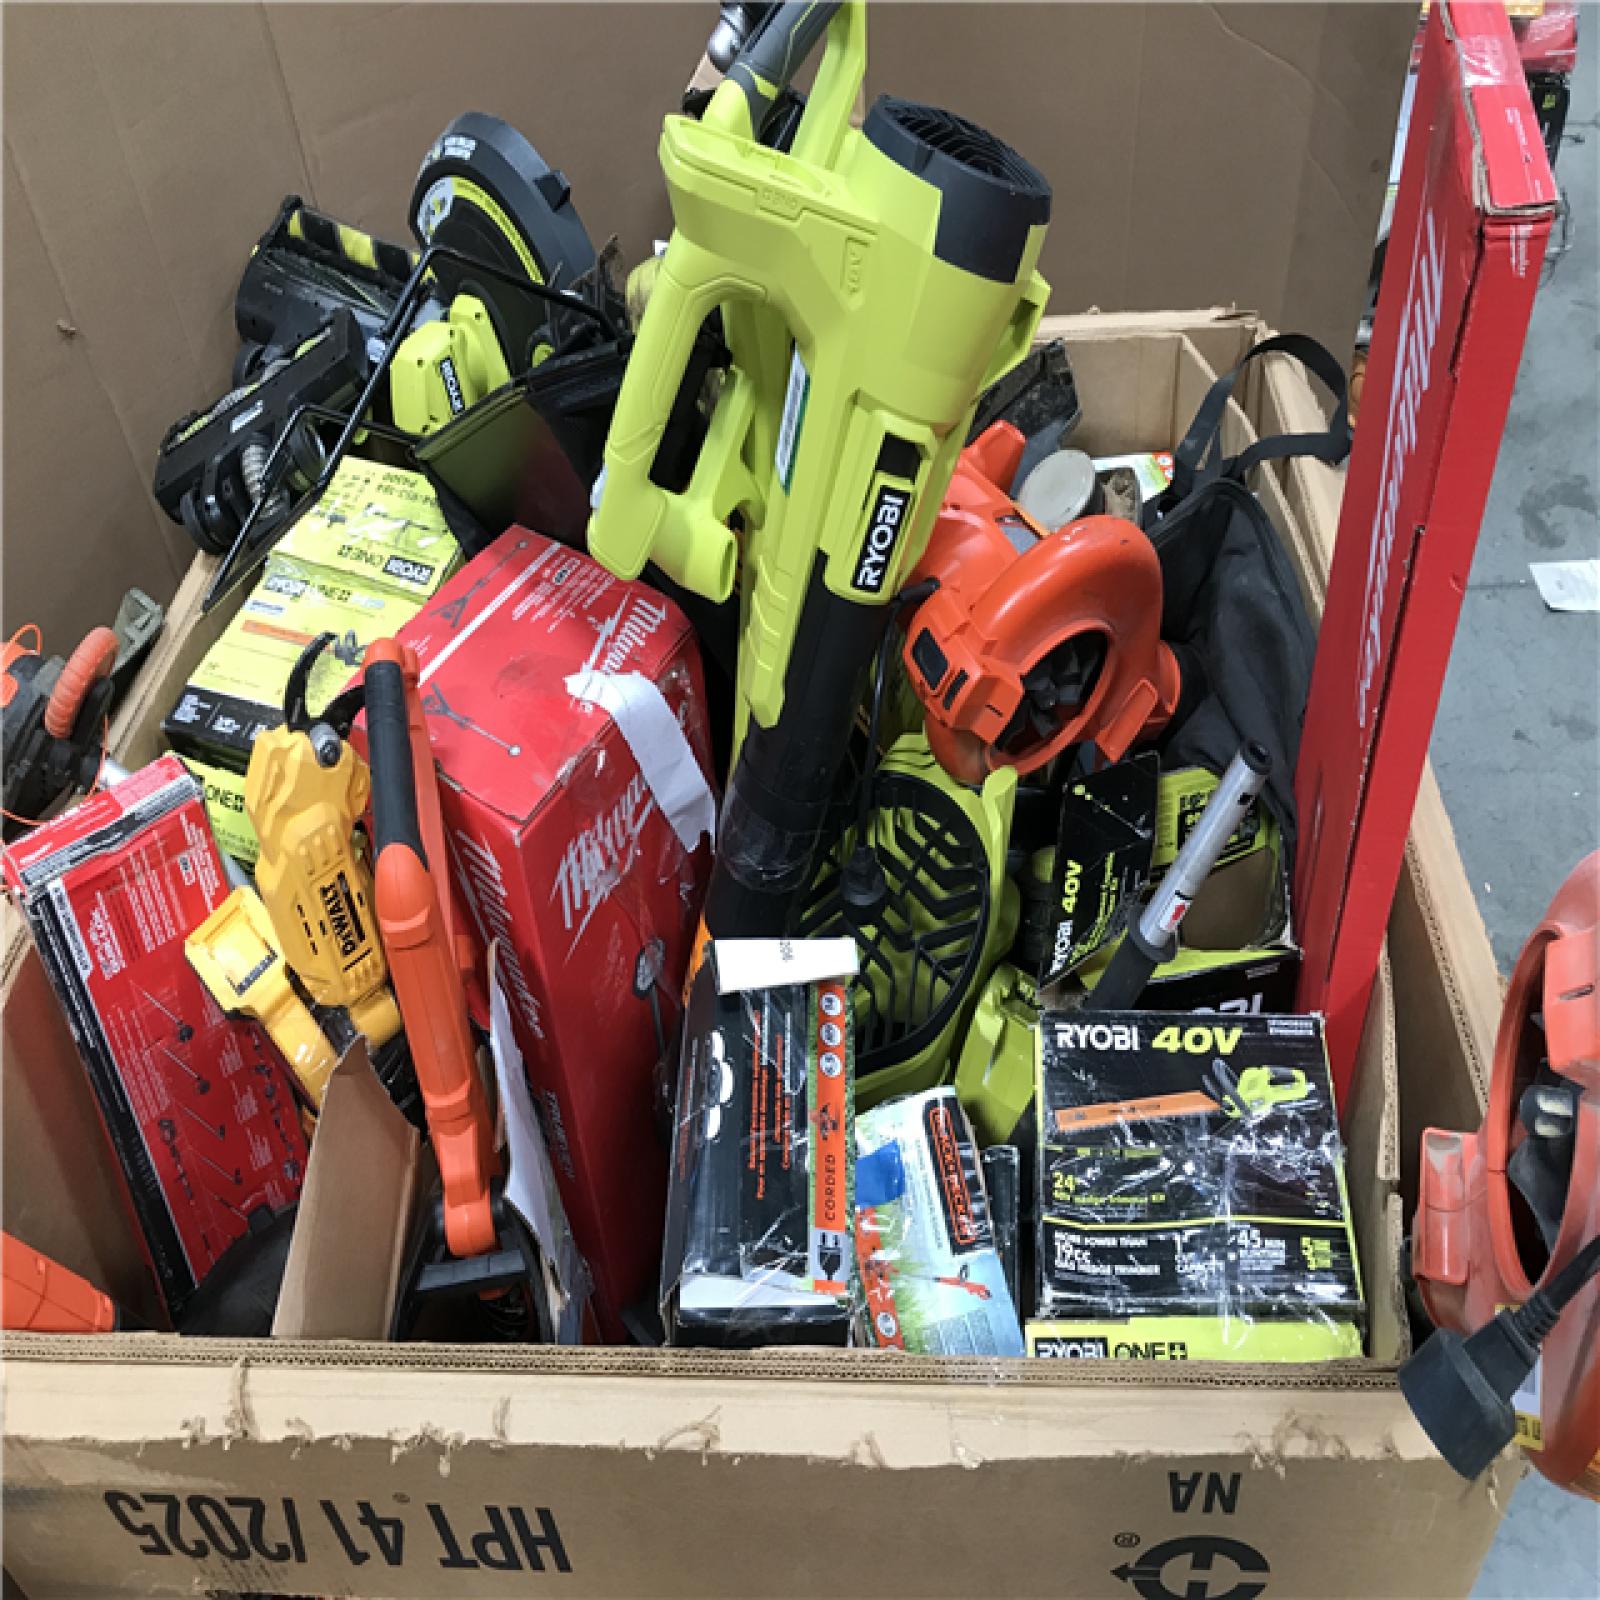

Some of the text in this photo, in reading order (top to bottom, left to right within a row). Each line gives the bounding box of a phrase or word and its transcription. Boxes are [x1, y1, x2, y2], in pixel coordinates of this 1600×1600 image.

[440, 358, 465, 416] RYOBI
[1356, 208, 1446, 728] Milwaukee
[855, 494, 907, 590] RYOBI
[1061, 859, 1083, 914] 40V
[319, 883, 357, 957] DEWALT
[455, 828, 546, 1040] Milwaukee
[1053, 1023, 1141, 1052] RYOBI
[1151, 1026, 1244, 1056] 40V
[824, 1154, 836, 1221] CORDED
[1114, 1264, 1161, 1276] TRIMMER
[1035, 1340, 1105, 1359] RYOBI
[1167, 1471, 1242, 1515] NA
[426, 1501, 574, 1573] HPT
